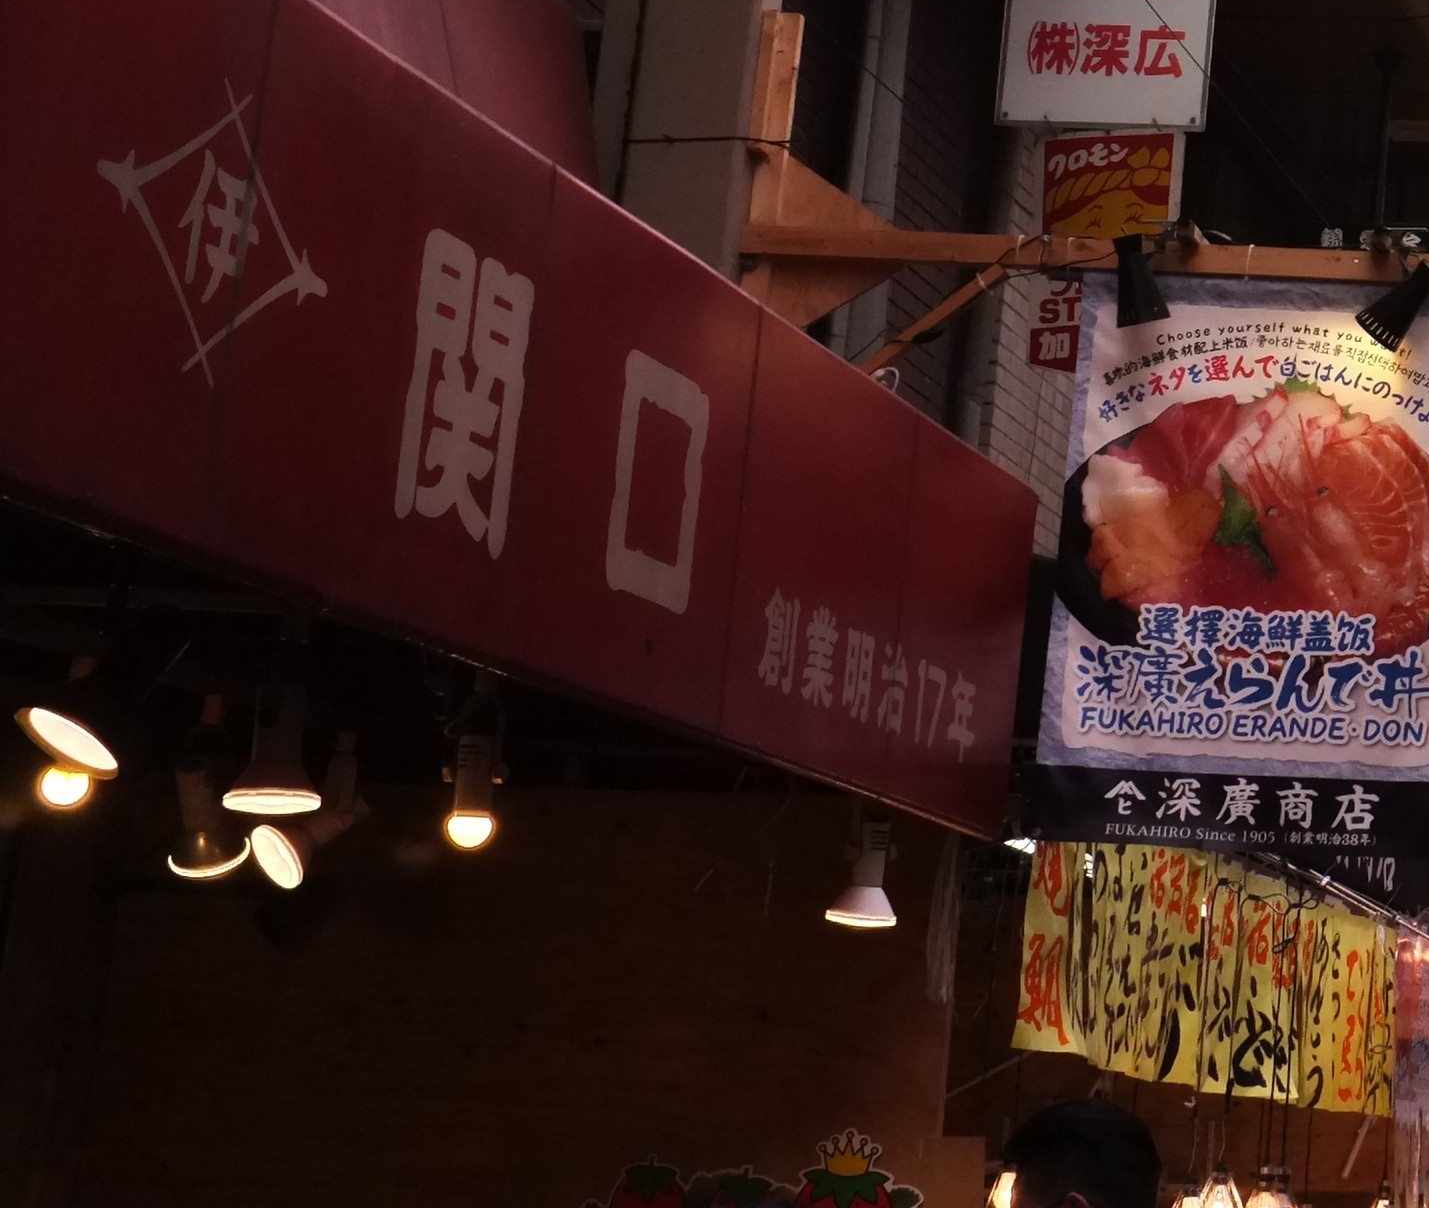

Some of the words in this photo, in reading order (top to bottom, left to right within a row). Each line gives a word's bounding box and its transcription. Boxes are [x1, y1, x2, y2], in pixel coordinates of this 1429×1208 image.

[1048, 142, 1129, 180] クロモン
[1156, 326, 1211, 346] Choose
[1218, 322, 1285, 335] yourself
[1292, 323, 1330, 338] what
[1337, 331, 1363, 344] you
[394, 228, 711, 613] 関口
[758, 589, 977, 763] 創業明治17年
[1080, 707, 1223, 736] FUKAHIRO
[1155, 778, 1381, 832] 深廣商店
[1105, 823, 1191, 840] FUKAHIRO
[1195, 827, 1236, 843] Since
[1242, 830, 1276, 844] 1905
